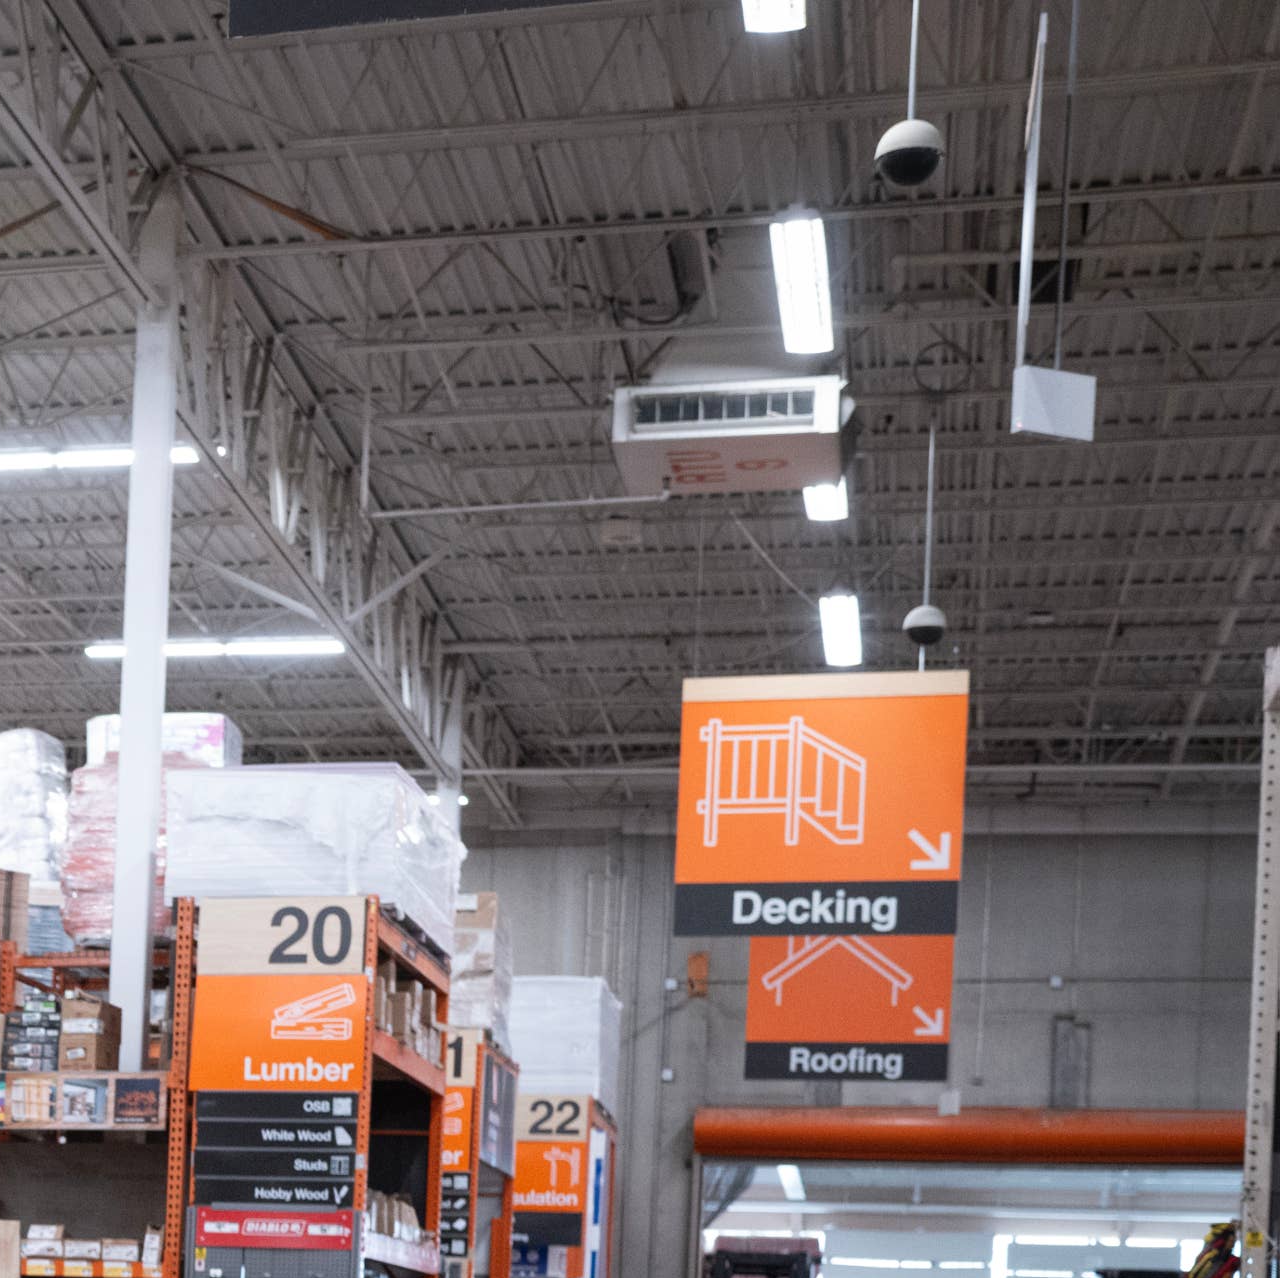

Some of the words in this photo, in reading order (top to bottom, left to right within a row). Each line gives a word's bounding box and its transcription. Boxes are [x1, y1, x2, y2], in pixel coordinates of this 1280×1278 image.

[733, 889, 897, 932] Decking
[268, 906, 352, 965] 20
[243, 1056, 354, 1082] Lumber
[448, 1037, 463, 1078] 1
[789, 1047, 903, 1080] Roofing
[303, 1100, 330, 1113] OSB
[529, 1101, 580, 1135] 22
[261, 1128, 295, 1142] White
[297, 1128, 332, 1141] Wood
[293, 1158, 328, 1171] Studs
[254, 1187, 293, 1203] Hobby
[295, 1187, 329, 1201] Wood
[513, 1189, 578, 1207] sulation
